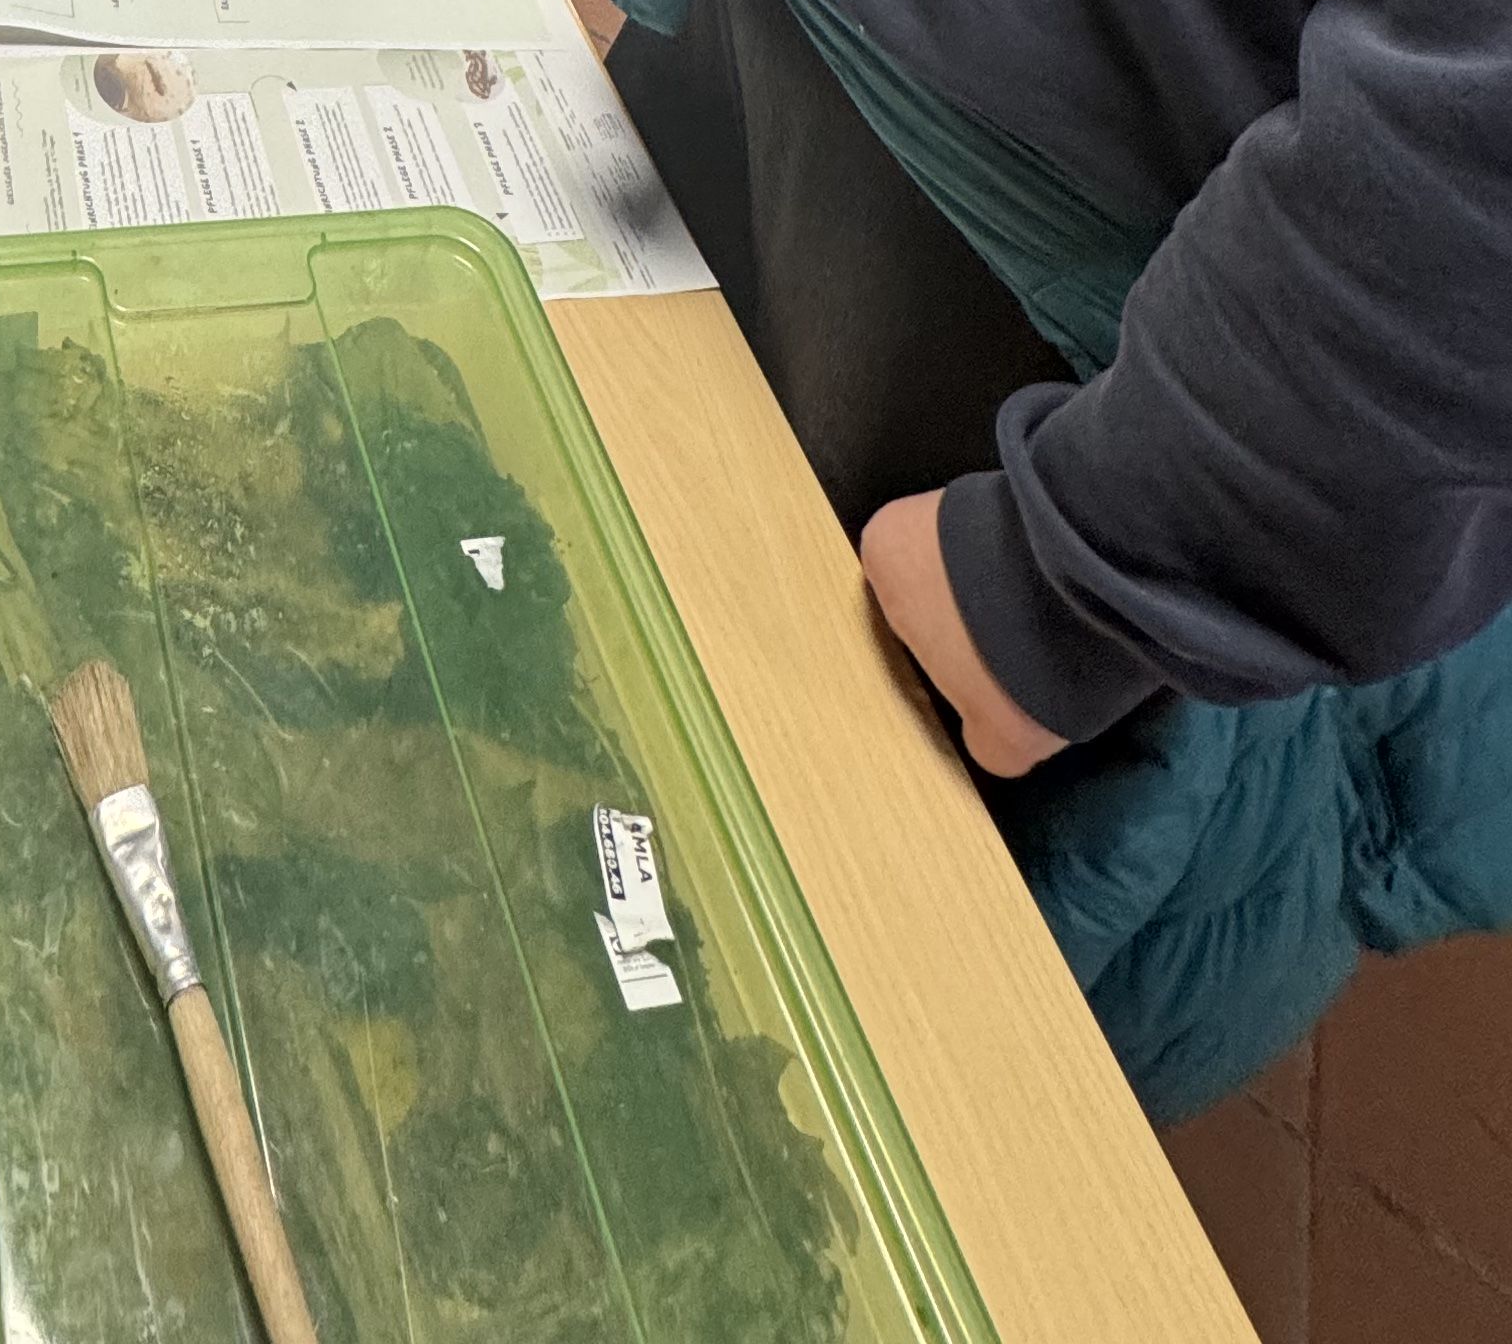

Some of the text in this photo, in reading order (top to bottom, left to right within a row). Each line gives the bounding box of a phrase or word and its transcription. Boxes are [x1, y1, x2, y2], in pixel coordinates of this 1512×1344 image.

[74, 139, 88, 168] PHASE
[298, 127, 315, 156] PHASE
[386, 134, 403, 163] PHASE
[479, 129, 497, 158] PHASE
[193, 146, 208, 176] PHASE
[308, 157, 332, 212] INRICHTUNG
[397, 164, 418, 200] PFLEGE
[492, 158, 514, 196] PFLEGE
[200, 178, 218, 214] PFLEGE
